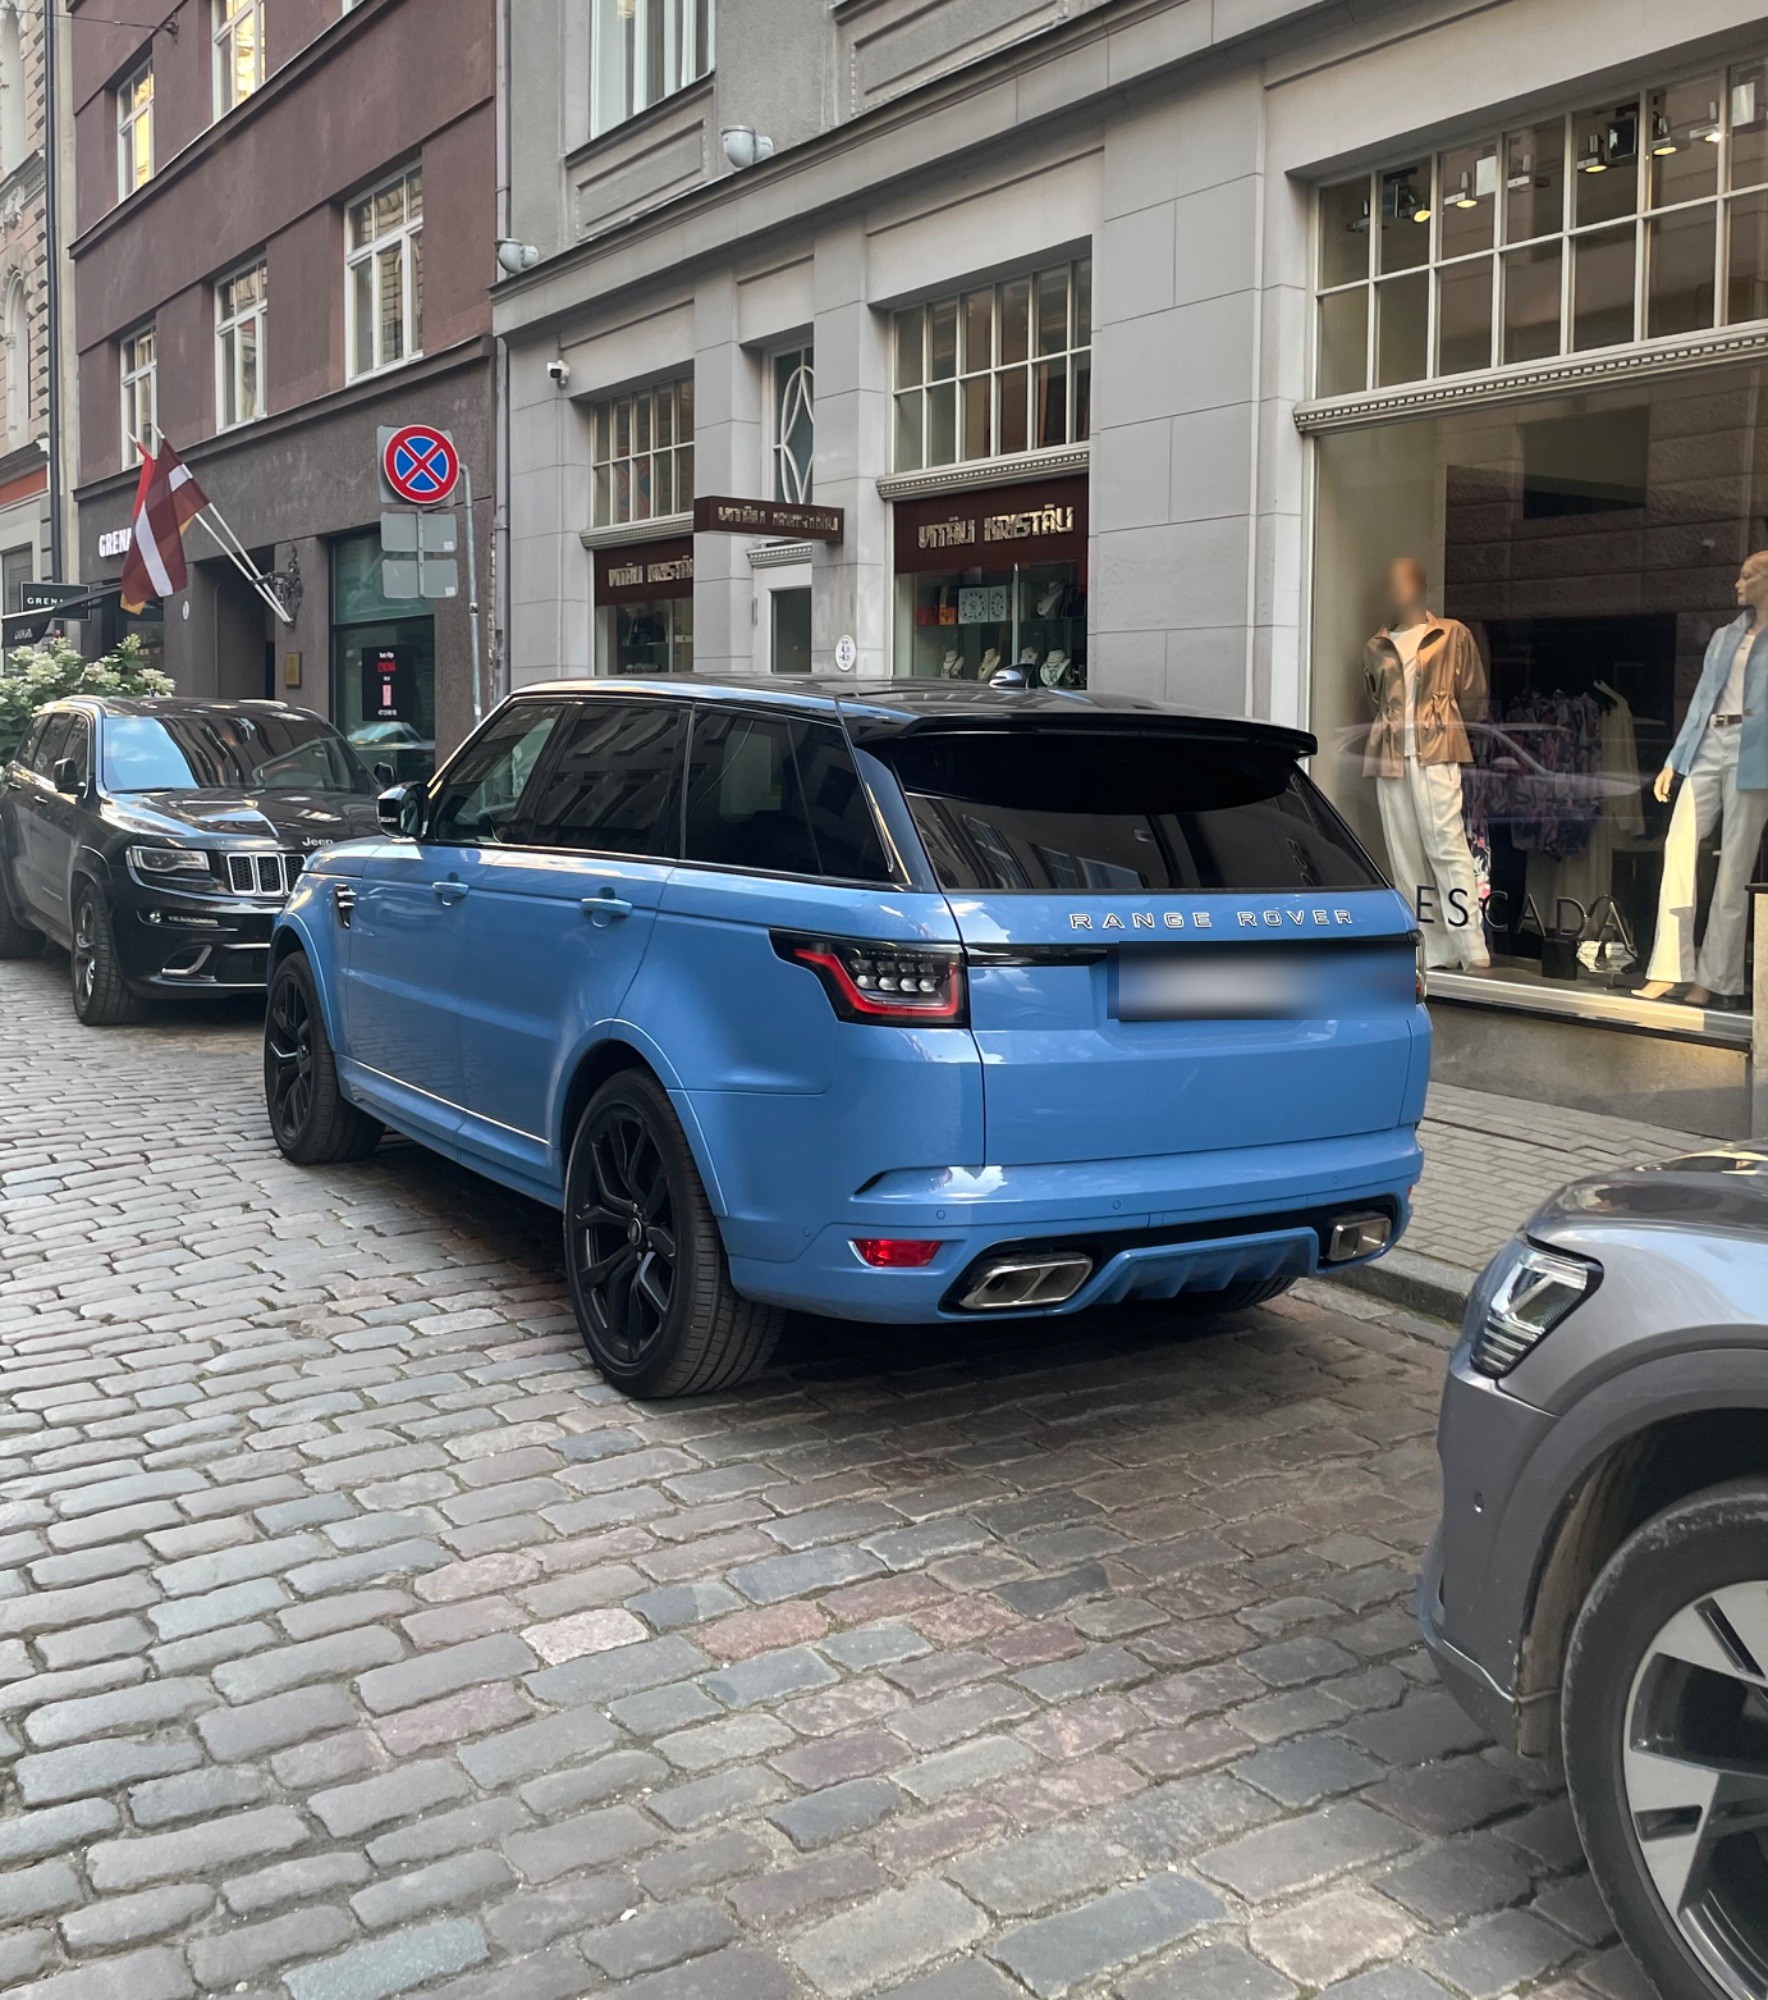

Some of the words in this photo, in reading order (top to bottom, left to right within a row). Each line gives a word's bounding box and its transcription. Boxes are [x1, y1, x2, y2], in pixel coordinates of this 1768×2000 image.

[1069, 912, 1213, 930] RANGE
[1236, 909, 1353, 927] ROVER
[1415, 885, 1631, 948] ESCADA
